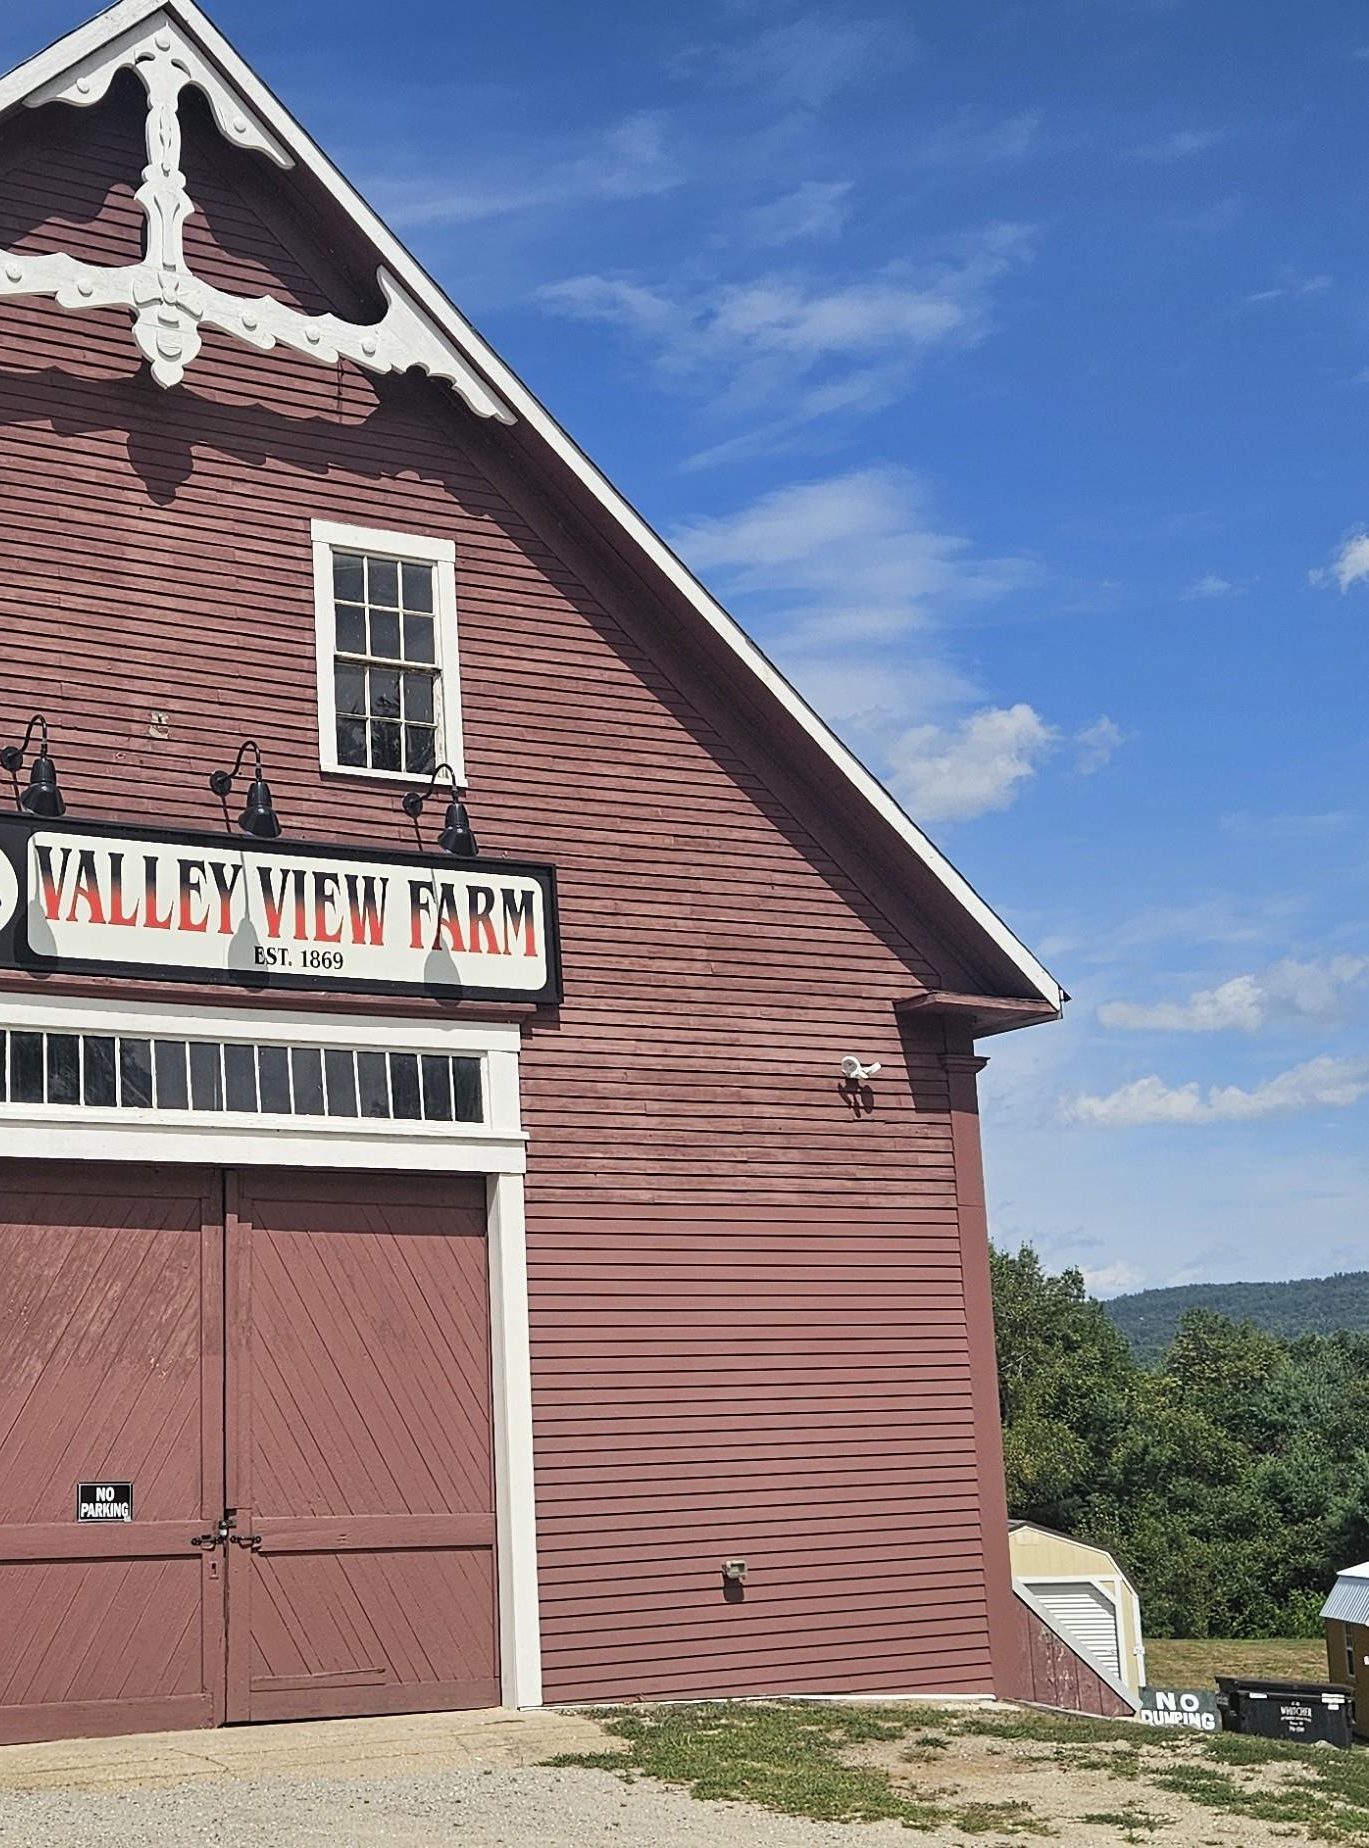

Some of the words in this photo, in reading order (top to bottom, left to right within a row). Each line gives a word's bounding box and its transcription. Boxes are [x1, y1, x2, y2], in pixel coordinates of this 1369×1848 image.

[35, 845, 243, 934] VALLEY
[257, 866, 389, 946] VIEW
[408, 879, 539, 957] FARM
[253, 945, 293, 967] EST.
[301, 949, 344, 970] 1869
[96, 1486, 114, 1501] NO
[81, 1502, 128, 1518] PARKING
[1156, 1691, 1199, 1712] NO
[1141, 1709, 1215, 1730] DUMPING
